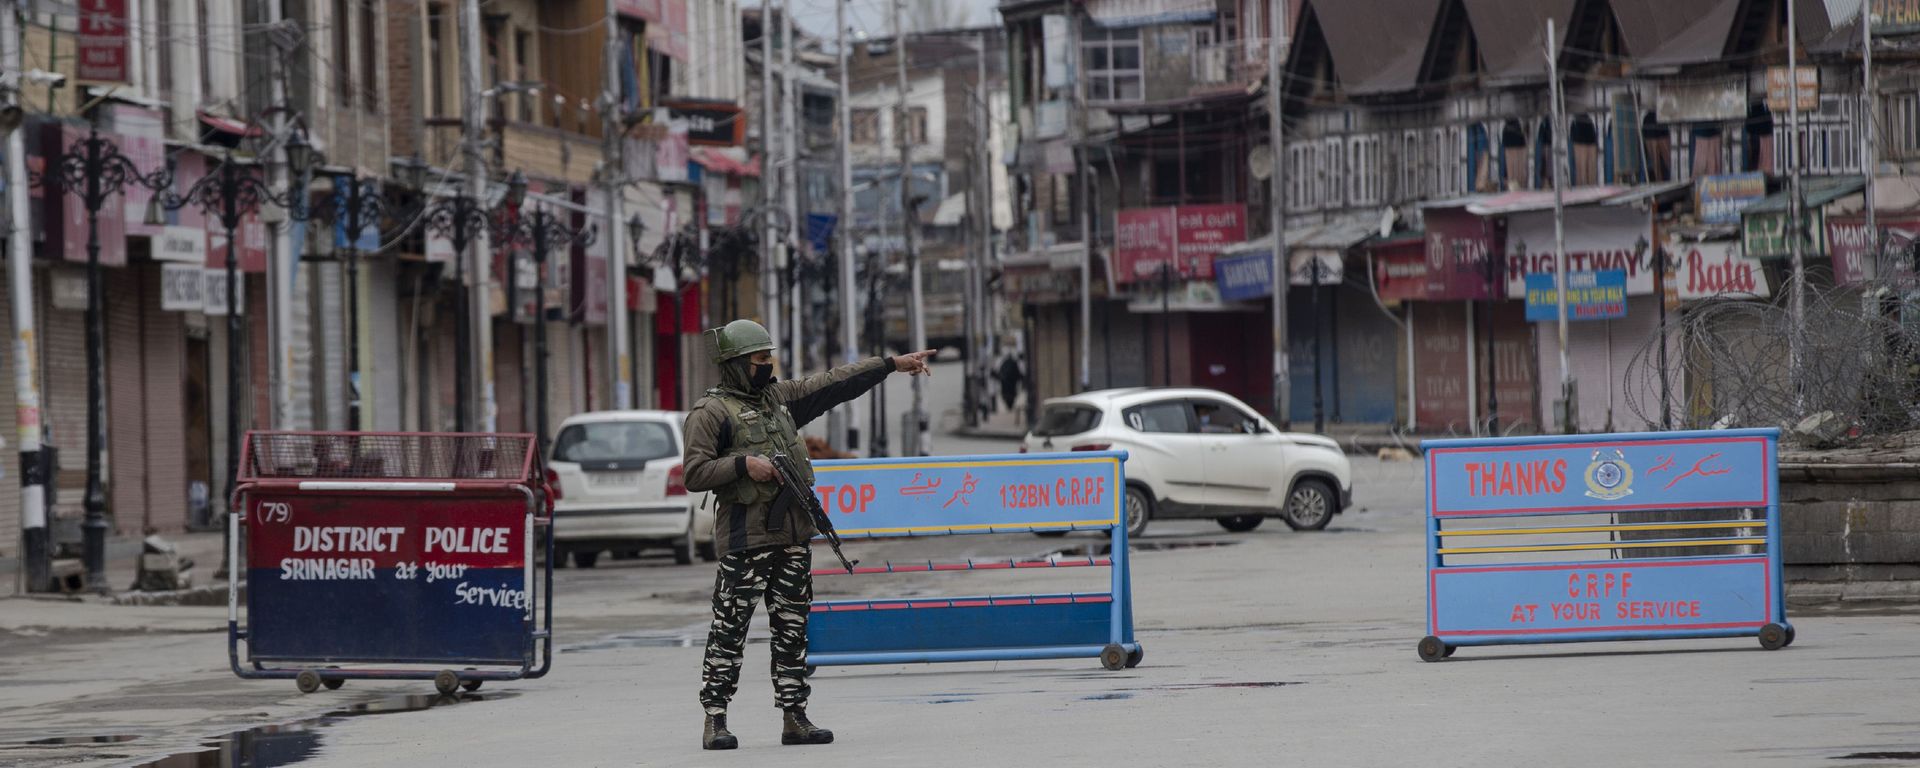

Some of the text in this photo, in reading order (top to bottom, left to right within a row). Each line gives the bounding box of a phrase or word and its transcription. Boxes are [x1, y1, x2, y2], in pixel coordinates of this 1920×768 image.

[1179, 213, 1203, 229] eat
[1452, 238, 1489, 264] TITAN
[1223, 258, 1268, 288] SAMSUNG
[1687, 248, 1756, 294] Bata
[1465, 458, 1568, 497] THANKS
[815, 484, 876, 513] TOP
[257, 502, 293, 526] (79)
[293, 526, 511, 554] DISTRICT POLICE
[280, 557, 467, 583] SRINAGAR at your
[454, 581, 525, 610] Service
[1510, 600, 1702, 623] AT YOUR SERVICE
